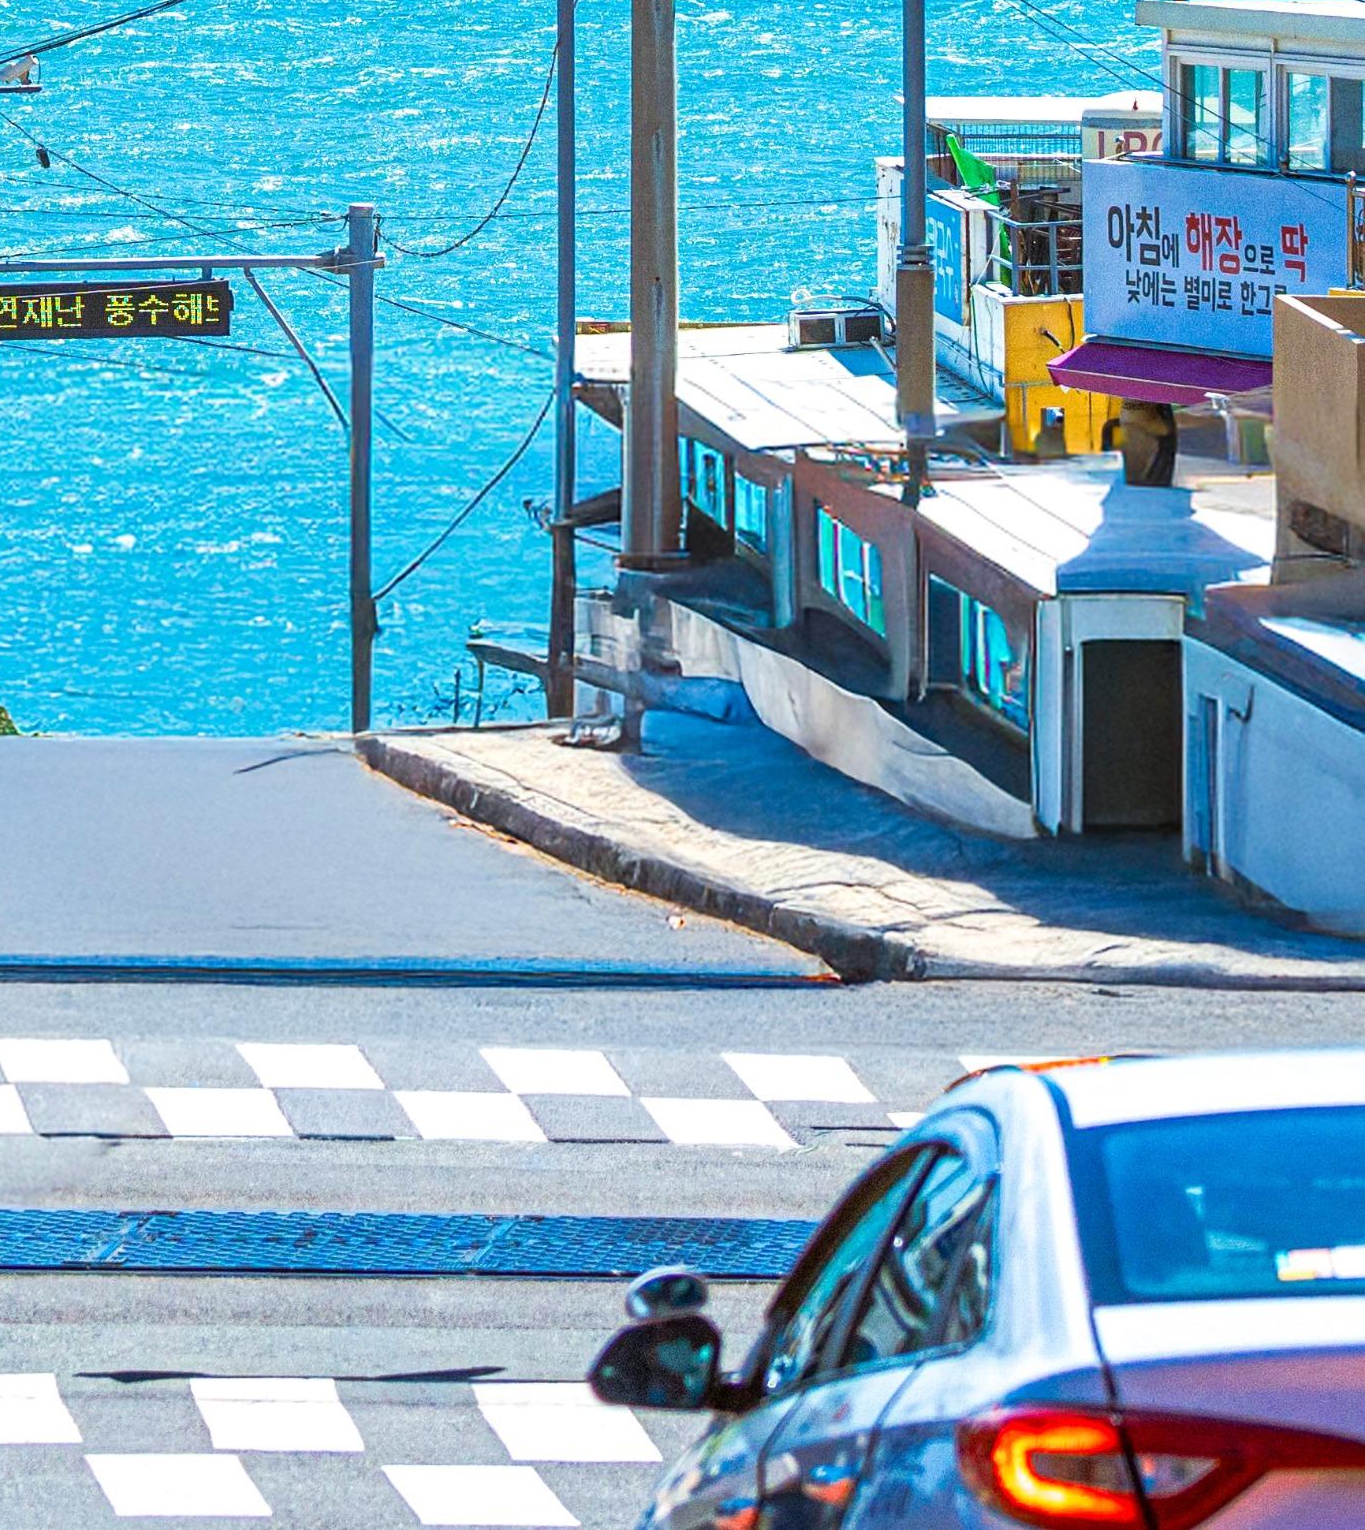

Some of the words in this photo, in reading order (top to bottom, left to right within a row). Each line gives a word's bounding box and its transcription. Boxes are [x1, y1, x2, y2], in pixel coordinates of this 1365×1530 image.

[1107, 203, 1179, 269] 아침에
[1185, 212, 1276, 276] 해장으로
[1281, 222, 1309, 283] 딱
[1125, 268, 1177, 308] 낮에는
[1184, 275, 1233, 312] 별미로
